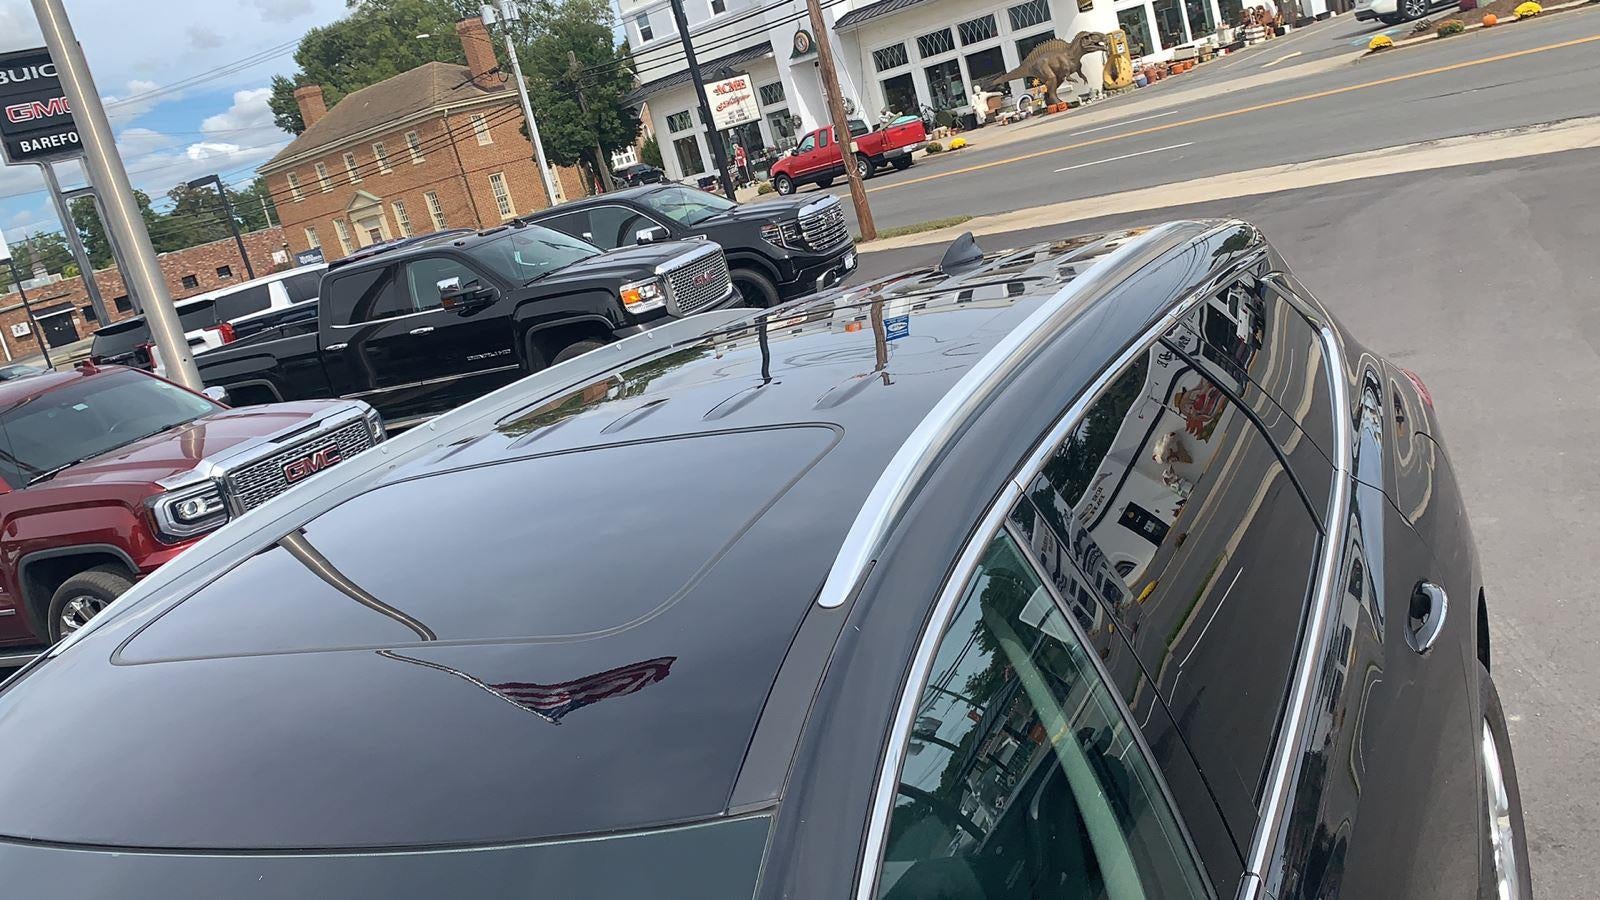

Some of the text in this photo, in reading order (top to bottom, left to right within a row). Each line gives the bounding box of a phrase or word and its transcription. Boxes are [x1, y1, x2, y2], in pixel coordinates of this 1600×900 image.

[5, 96, 72, 123] GM
[20, 132, 79, 152] BAREFO
[283, 445, 341, 482] GMC
